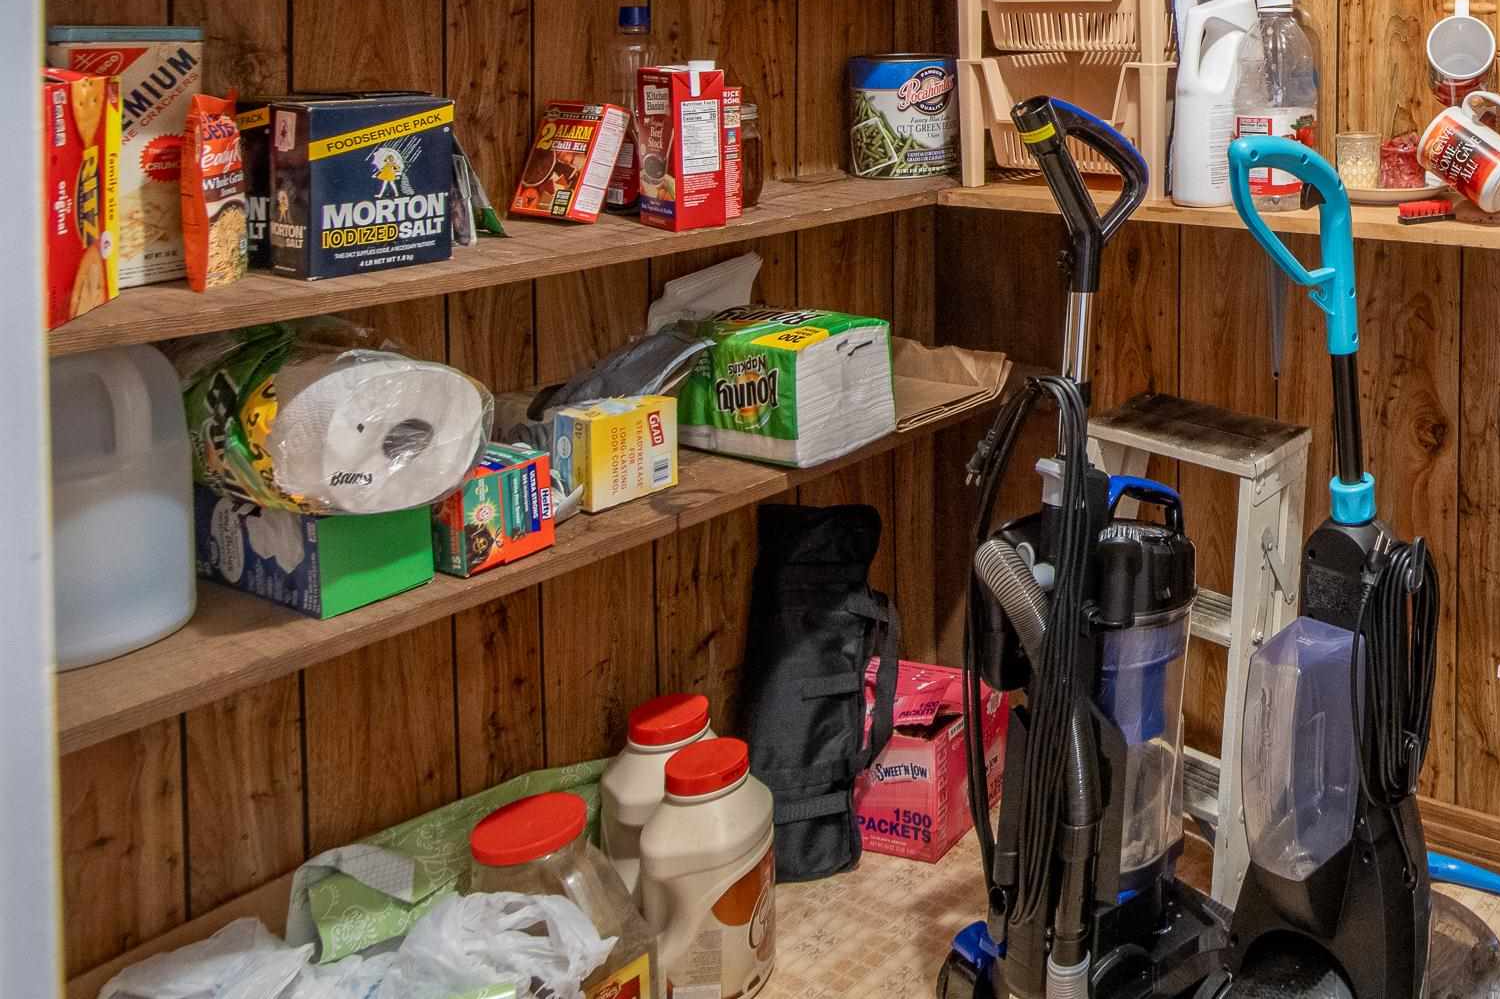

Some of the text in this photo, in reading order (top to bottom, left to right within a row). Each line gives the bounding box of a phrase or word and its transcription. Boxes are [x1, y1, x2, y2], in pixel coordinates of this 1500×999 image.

[326, 113, 442, 152] FOODSERVICE PACK
[537, 123, 593, 150] 2 ALARM
[896, 122, 942, 133] CUT GREEN
[145, 160, 181, 171] CRUNC
[78, 145, 100, 249] RITZ
[106, 153, 117, 221] family size
[55, 181, 69, 235] original
[321, 192, 445, 229] MORTON
[249, 222, 266, 240] LT
[286, 239, 304, 249] SALT
[321, 217, 444, 249] IODIZED SALT
[778, 333, 806, 344] 200
[728, 354, 768, 377] Napkins
[715, 368, 779, 414] Bounty
[648, 414, 663, 446] GLAD
[610, 426, 619, 496] ODOR CONTROL
[541, 488, 551, 519] Hefty
[910, 762, 929, 780] LOW
[856, 814, 932, 843] PACKETS
[893, 807, 932, 829] 1500
